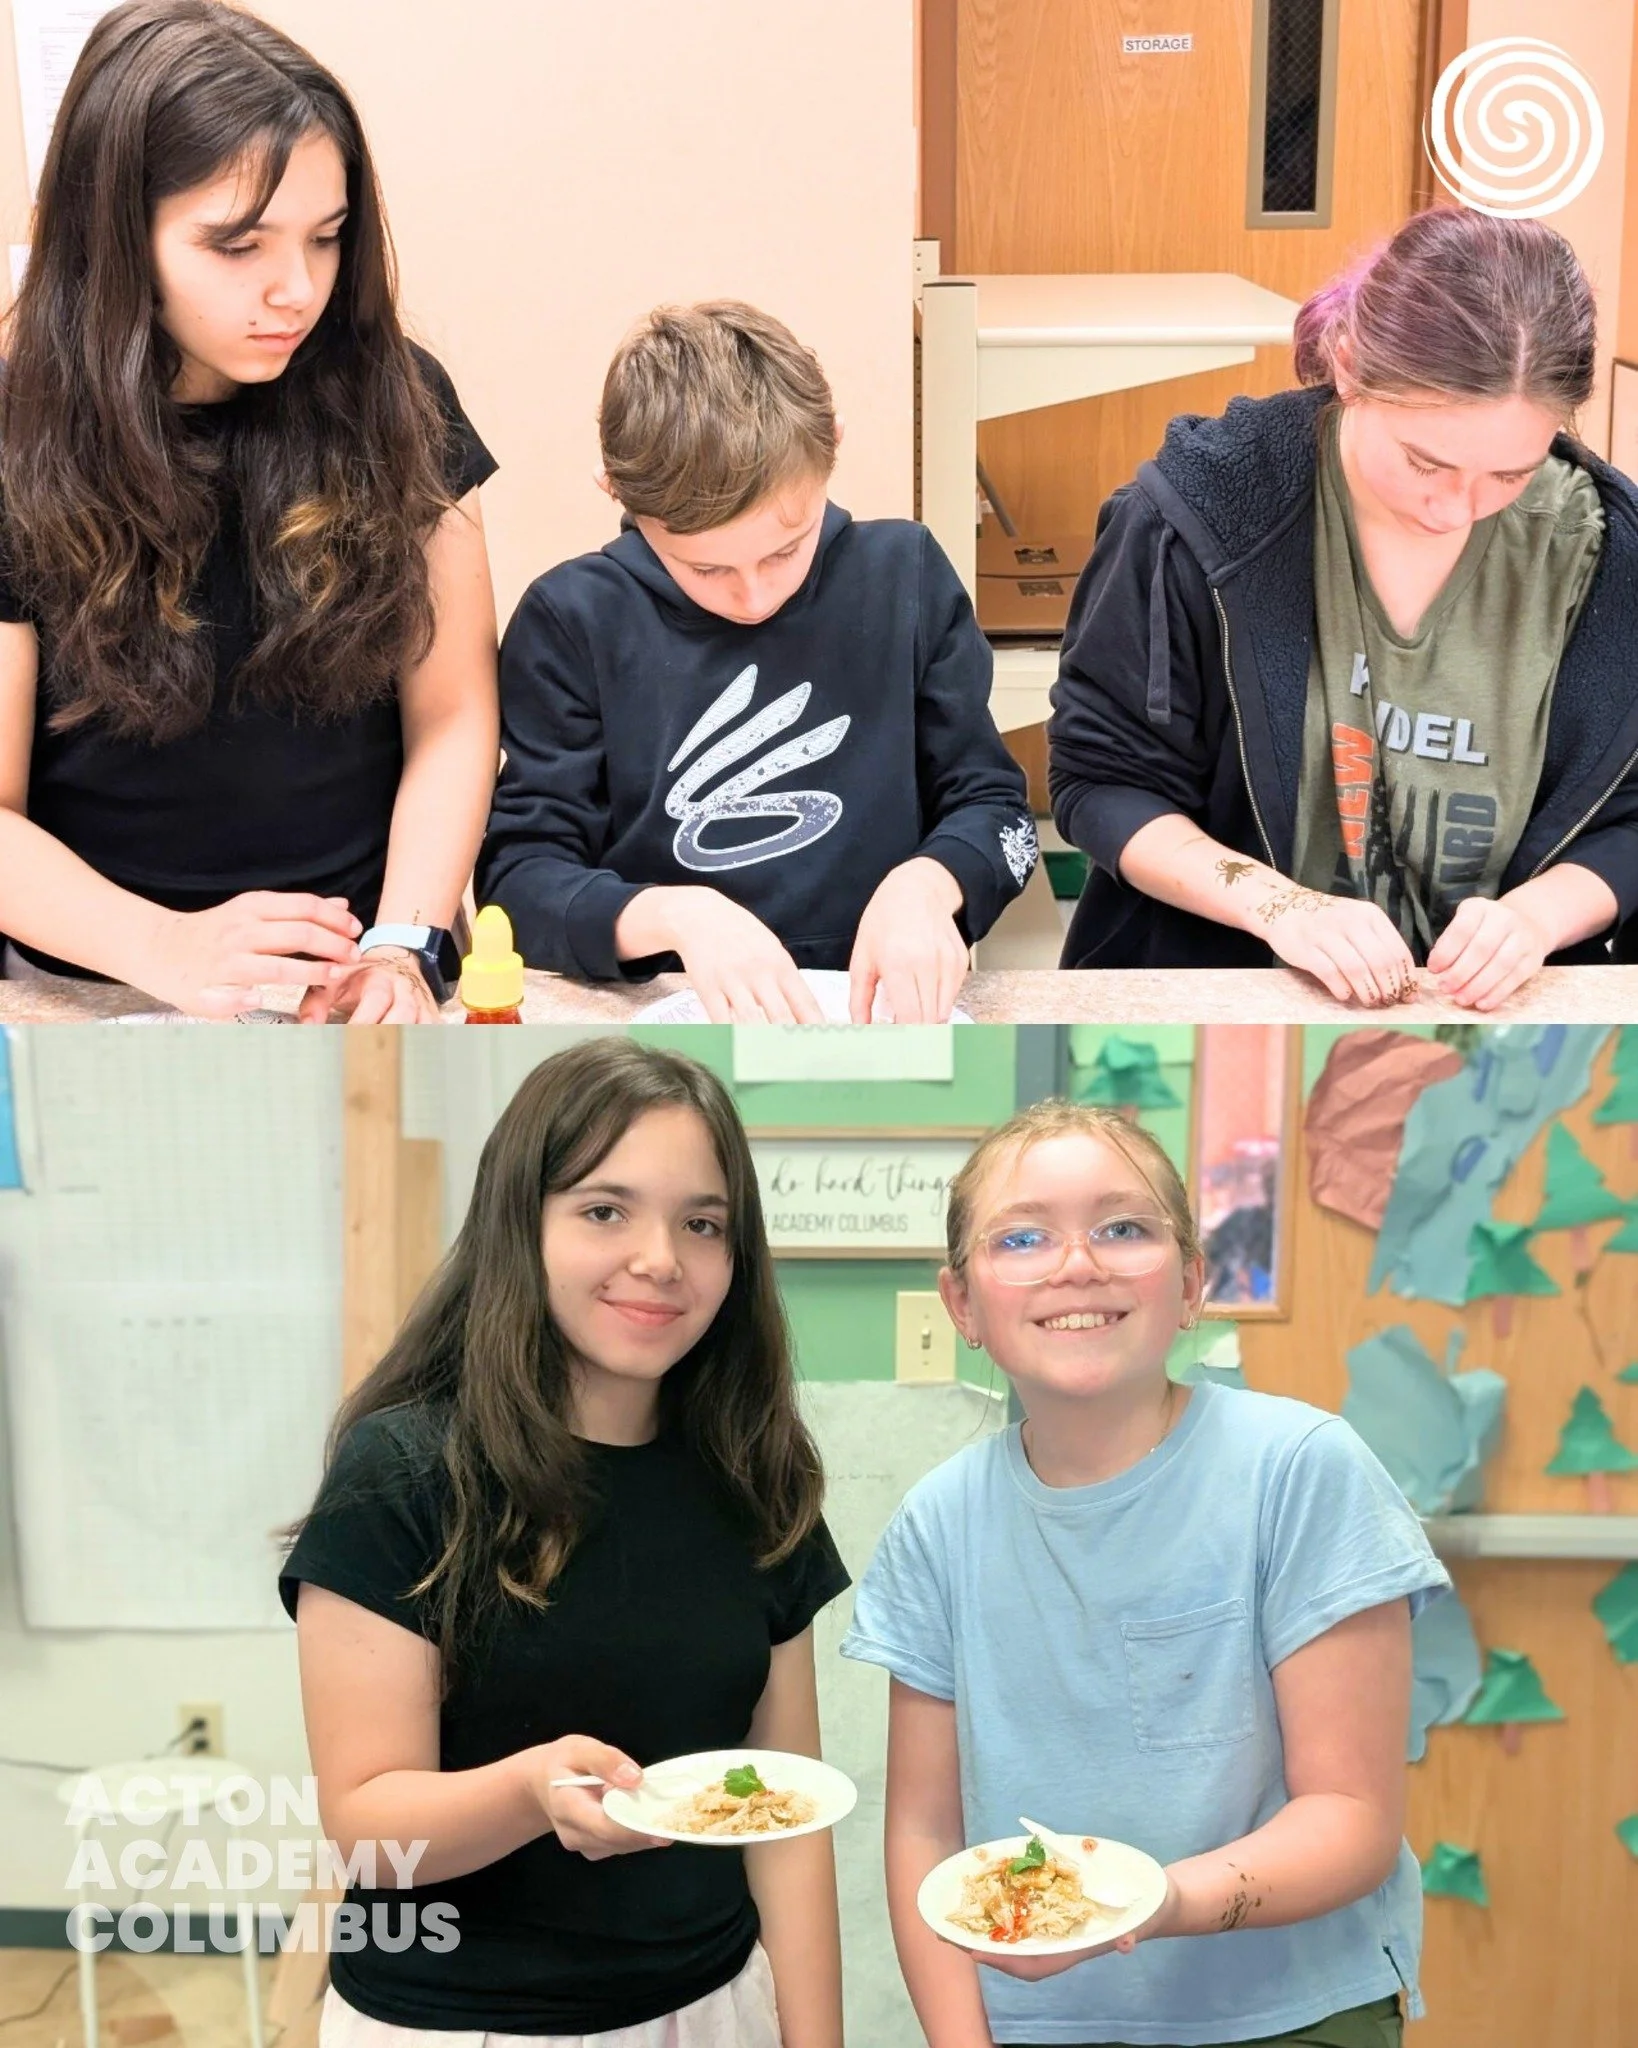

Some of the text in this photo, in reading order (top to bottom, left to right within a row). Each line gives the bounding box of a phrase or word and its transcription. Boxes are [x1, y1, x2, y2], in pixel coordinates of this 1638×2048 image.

[1125, 38, 1190, 52] STORAGE
[771, 1156, 804, 1197] do
[771, 1212, 834, 1233] ACADEMY
[838, 1212, 909, 1233] COLUMBUS
